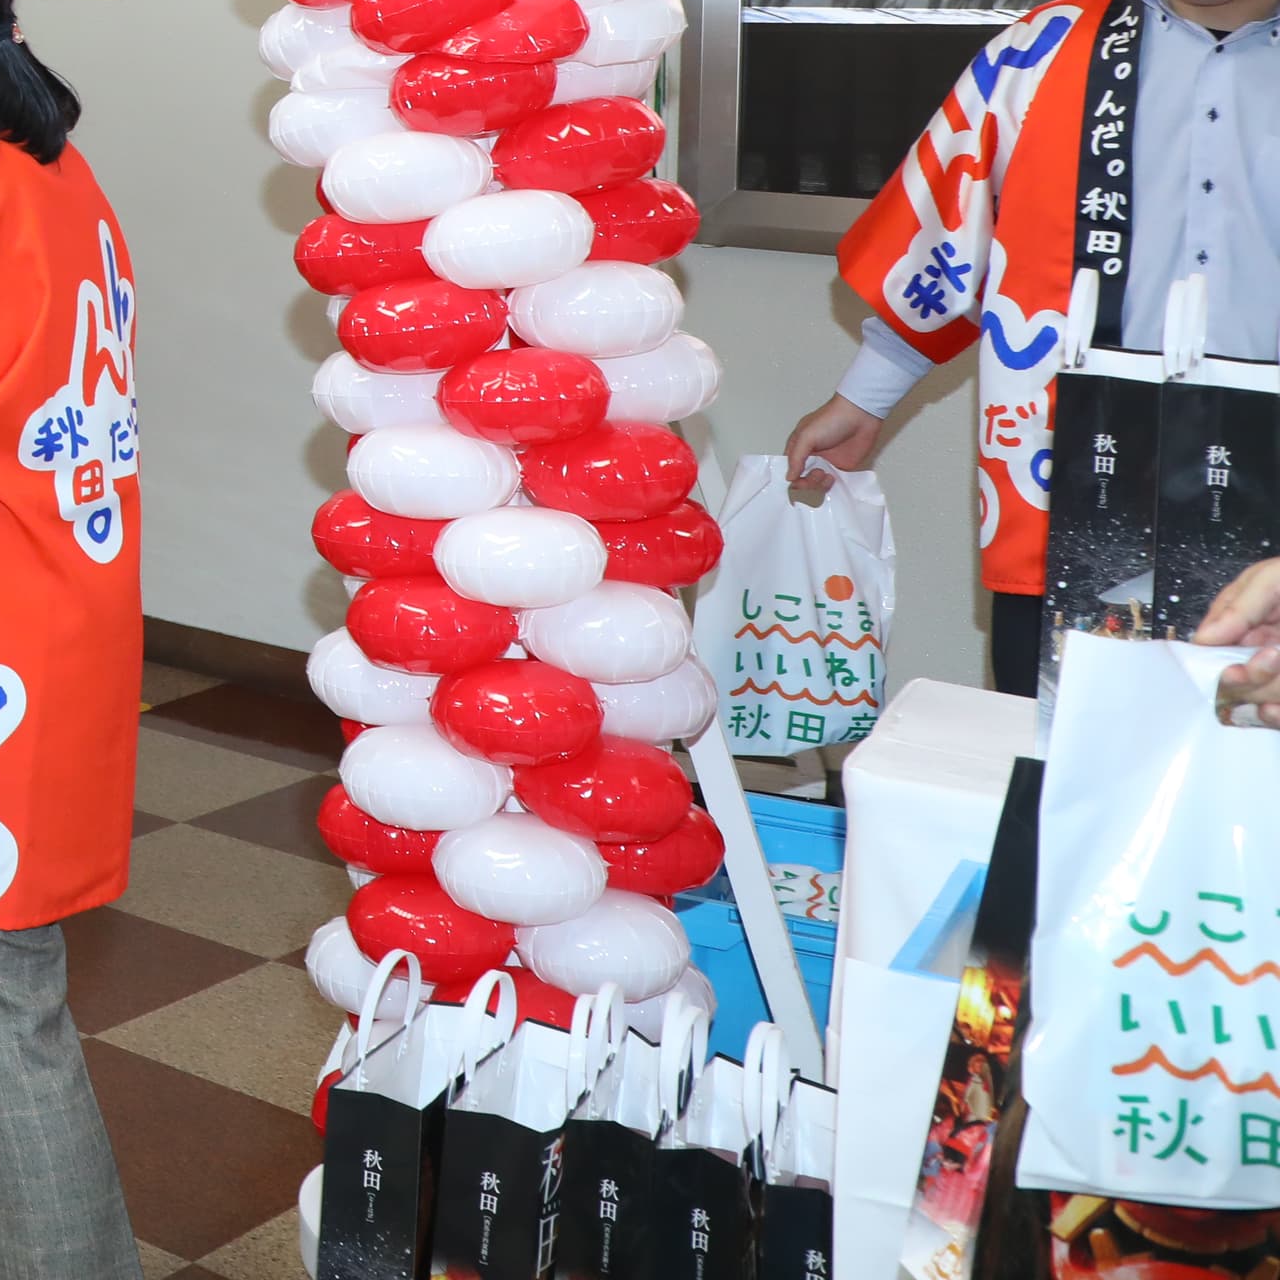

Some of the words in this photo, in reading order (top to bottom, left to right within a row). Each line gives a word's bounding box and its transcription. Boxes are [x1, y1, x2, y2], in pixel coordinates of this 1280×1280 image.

[1081, 6, 1138, 276] んだ。んだ。秋田。
[1093, 433, 1118, 475] 秋田
[1206, 445, 1232, 487] 秋田
[736, 651, 877, 688] いいね!
[363, 1148, 383, 1191] 秋田
[480, 1171, 500, 1214] 秋田
[599, 1178, 619, 1221] 秋田
[691, 1208, 711, 1253] 秋田
